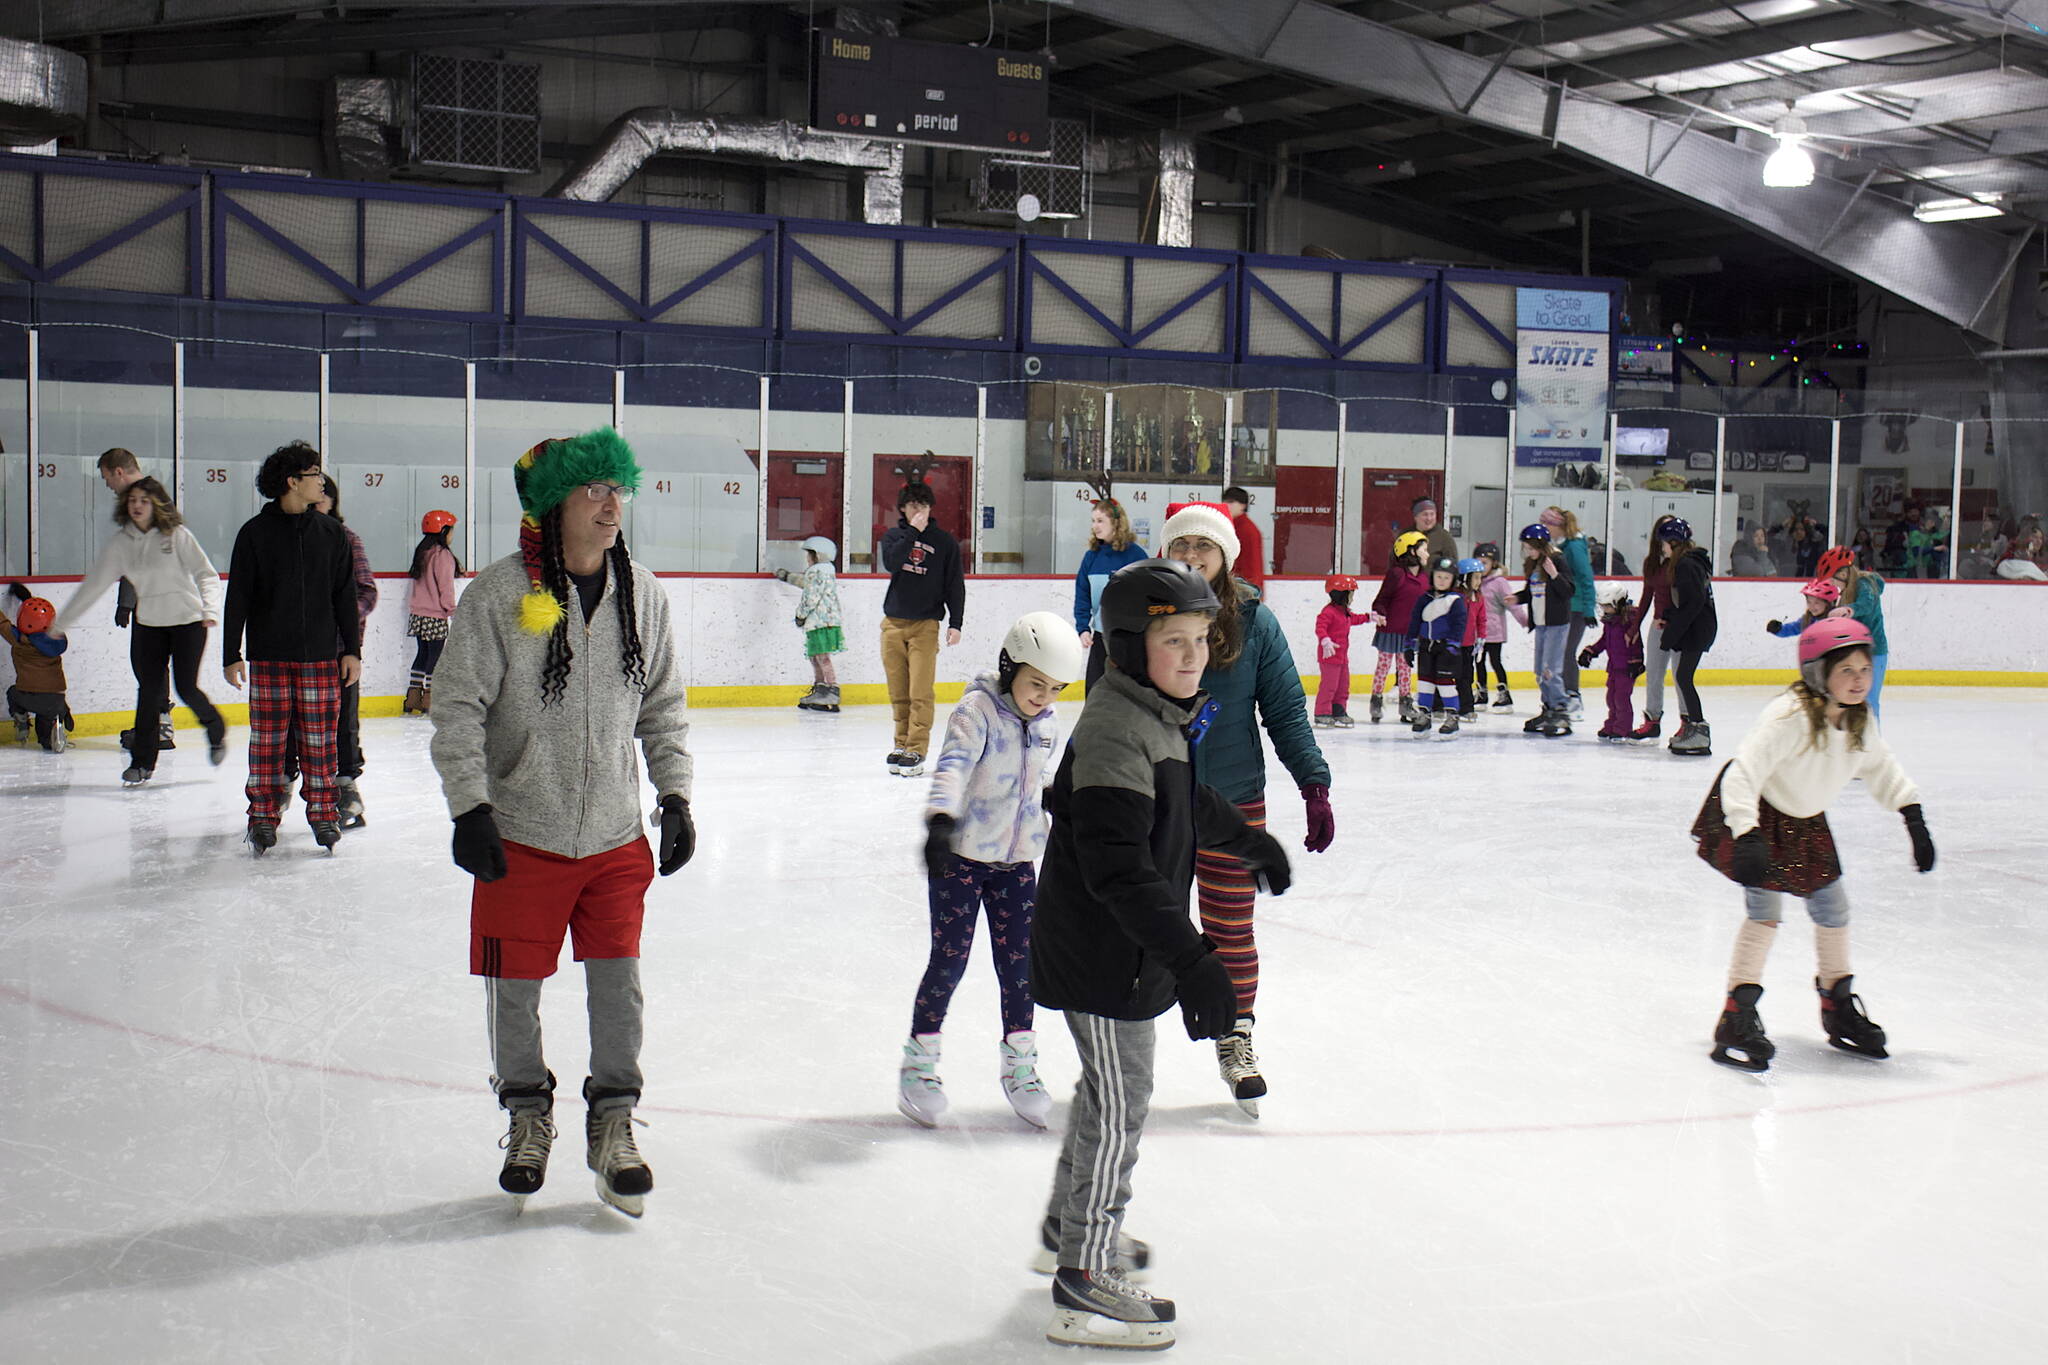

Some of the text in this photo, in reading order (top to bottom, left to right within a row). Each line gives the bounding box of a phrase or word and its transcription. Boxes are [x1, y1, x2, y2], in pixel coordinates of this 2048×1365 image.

[832, 38, 871, 61] Home
[997, 57, 1043, 81] Guests
[914, 113, 959, 132] period
[1543, 294, 1582, 310] Skate
[1535, 310, 1592, 328] to Great
[1528, 345, 1598, 367] SKATE
[206, 468, 227, 483] 35
[364, 473, 384, 487] 37
[441, 475, 460, 488] 38
[656, 480, 671, 493] 41
[723, 481, 740, 495] 42
[1076, 489, 1090, 501] 43
[1133, 491, 1147, 503] 44
[1872, 484, 1892, 507] 20
[1315, 506, 1331, 514] ONLY
